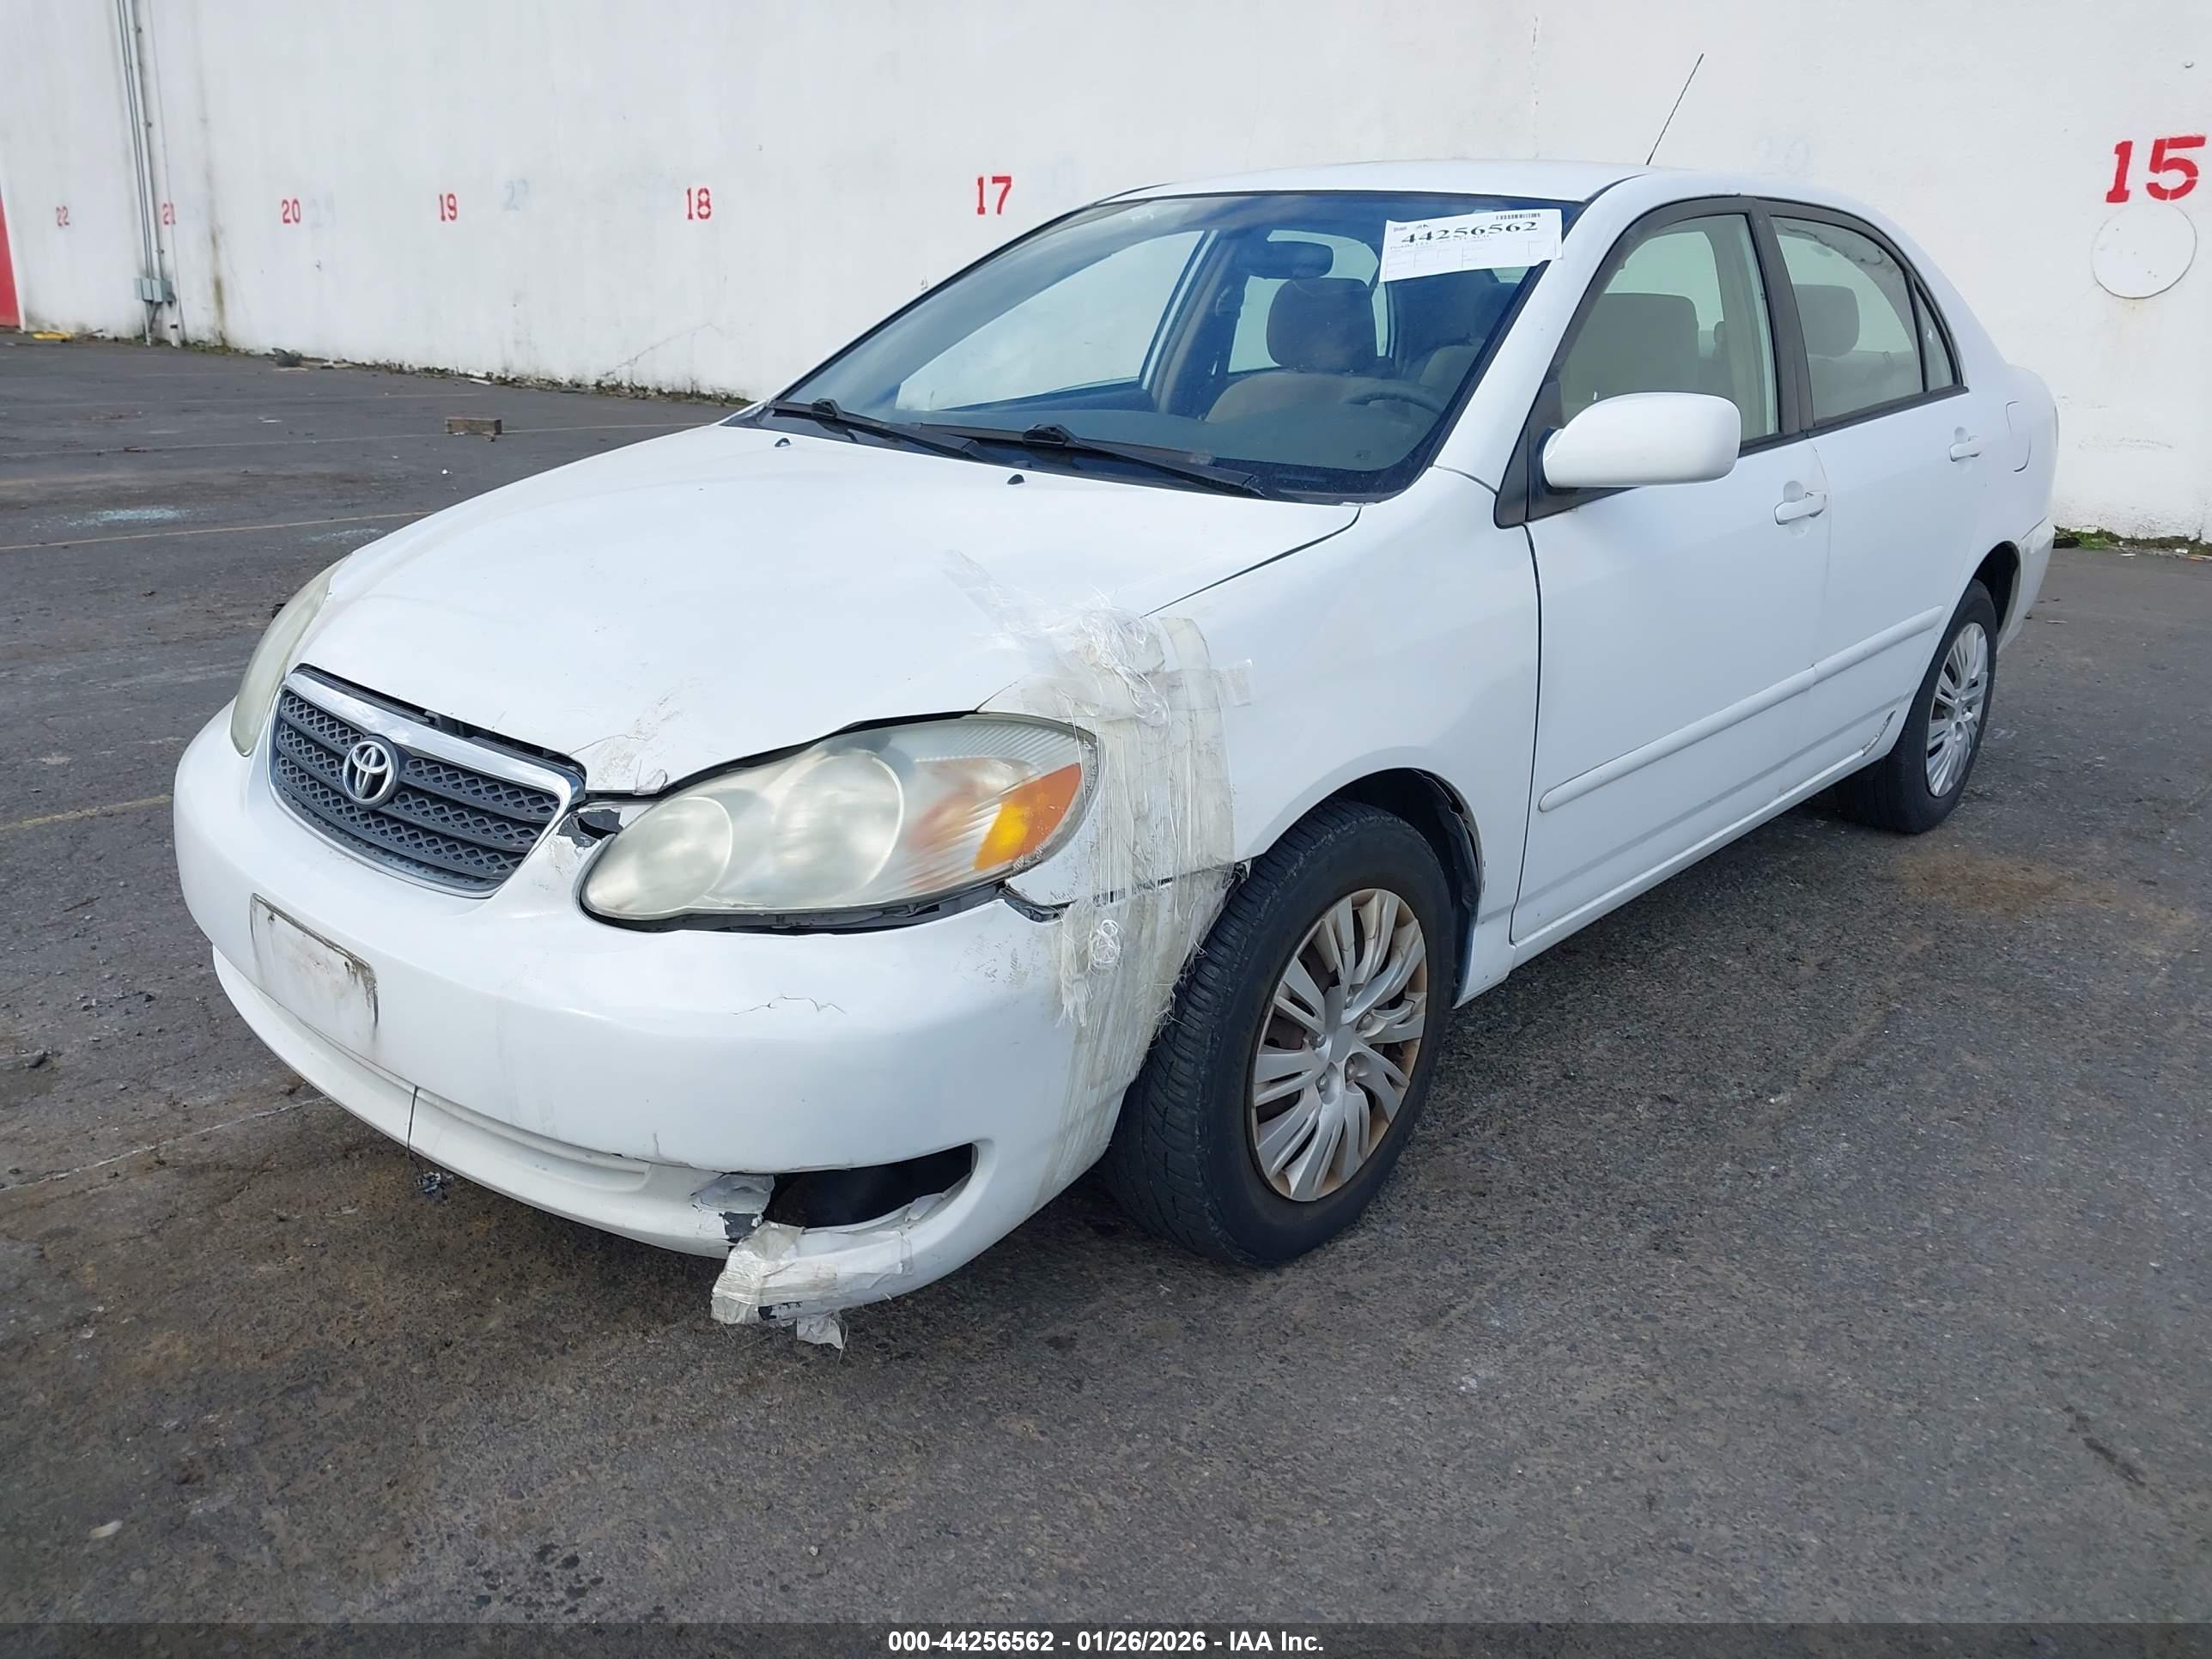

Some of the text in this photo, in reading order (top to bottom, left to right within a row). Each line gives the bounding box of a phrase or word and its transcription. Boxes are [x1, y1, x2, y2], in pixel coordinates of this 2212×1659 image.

[2105, 133, 2208, 204] 15
[439, 192, 458, 222] 19
[686, 186, 713, 221] 18
[975, 174, 1013, 216] 17
[56, 205, 70, 227] 22
[162, 203, 176, 225] 21
[281, 198, 301, 225] 20
[1401, 221, 1539, 243] 44256562
